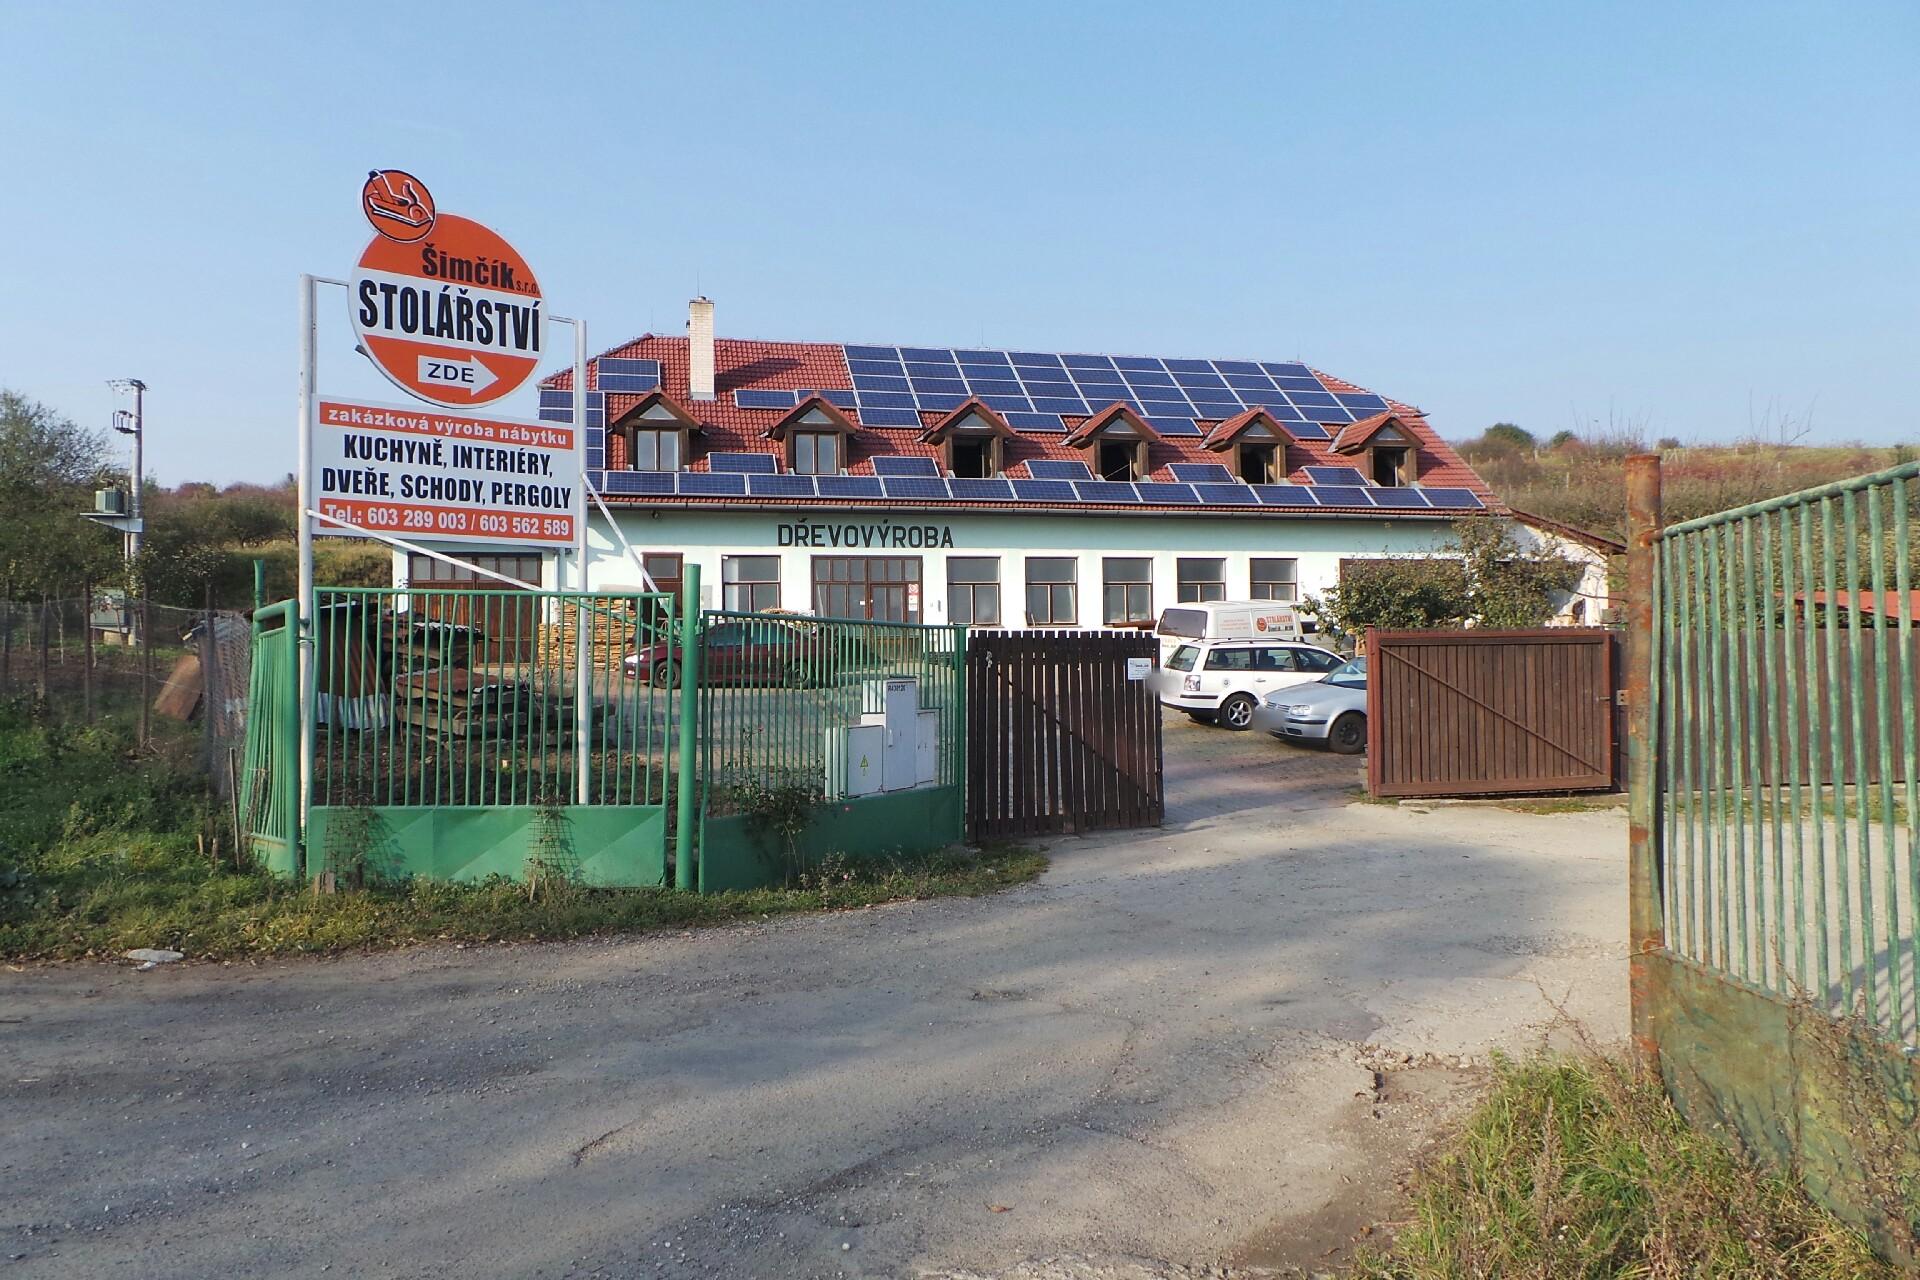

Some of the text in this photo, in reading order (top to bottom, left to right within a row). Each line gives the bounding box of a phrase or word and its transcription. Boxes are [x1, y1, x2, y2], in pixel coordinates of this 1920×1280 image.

[422, 242, 514, 290] Šimčík
[359, 279, 540, 352] STOLÁŘSTVÍ
[427, 362, 474, 383] ZDE
[328, 408, 567, 445] zakázková výroba nábytku
[344, 434, 553, 478] KUCHYNĚ, INTERIÉRY,
[322, 467, 571, 509] DVEŘE, SCHODY, PERGOLY
[325, 504, 569, 536] Tel.: 603 289 003 / 603 562 589
[777, 518, 954, 548] DŘEVOVÝROBA
